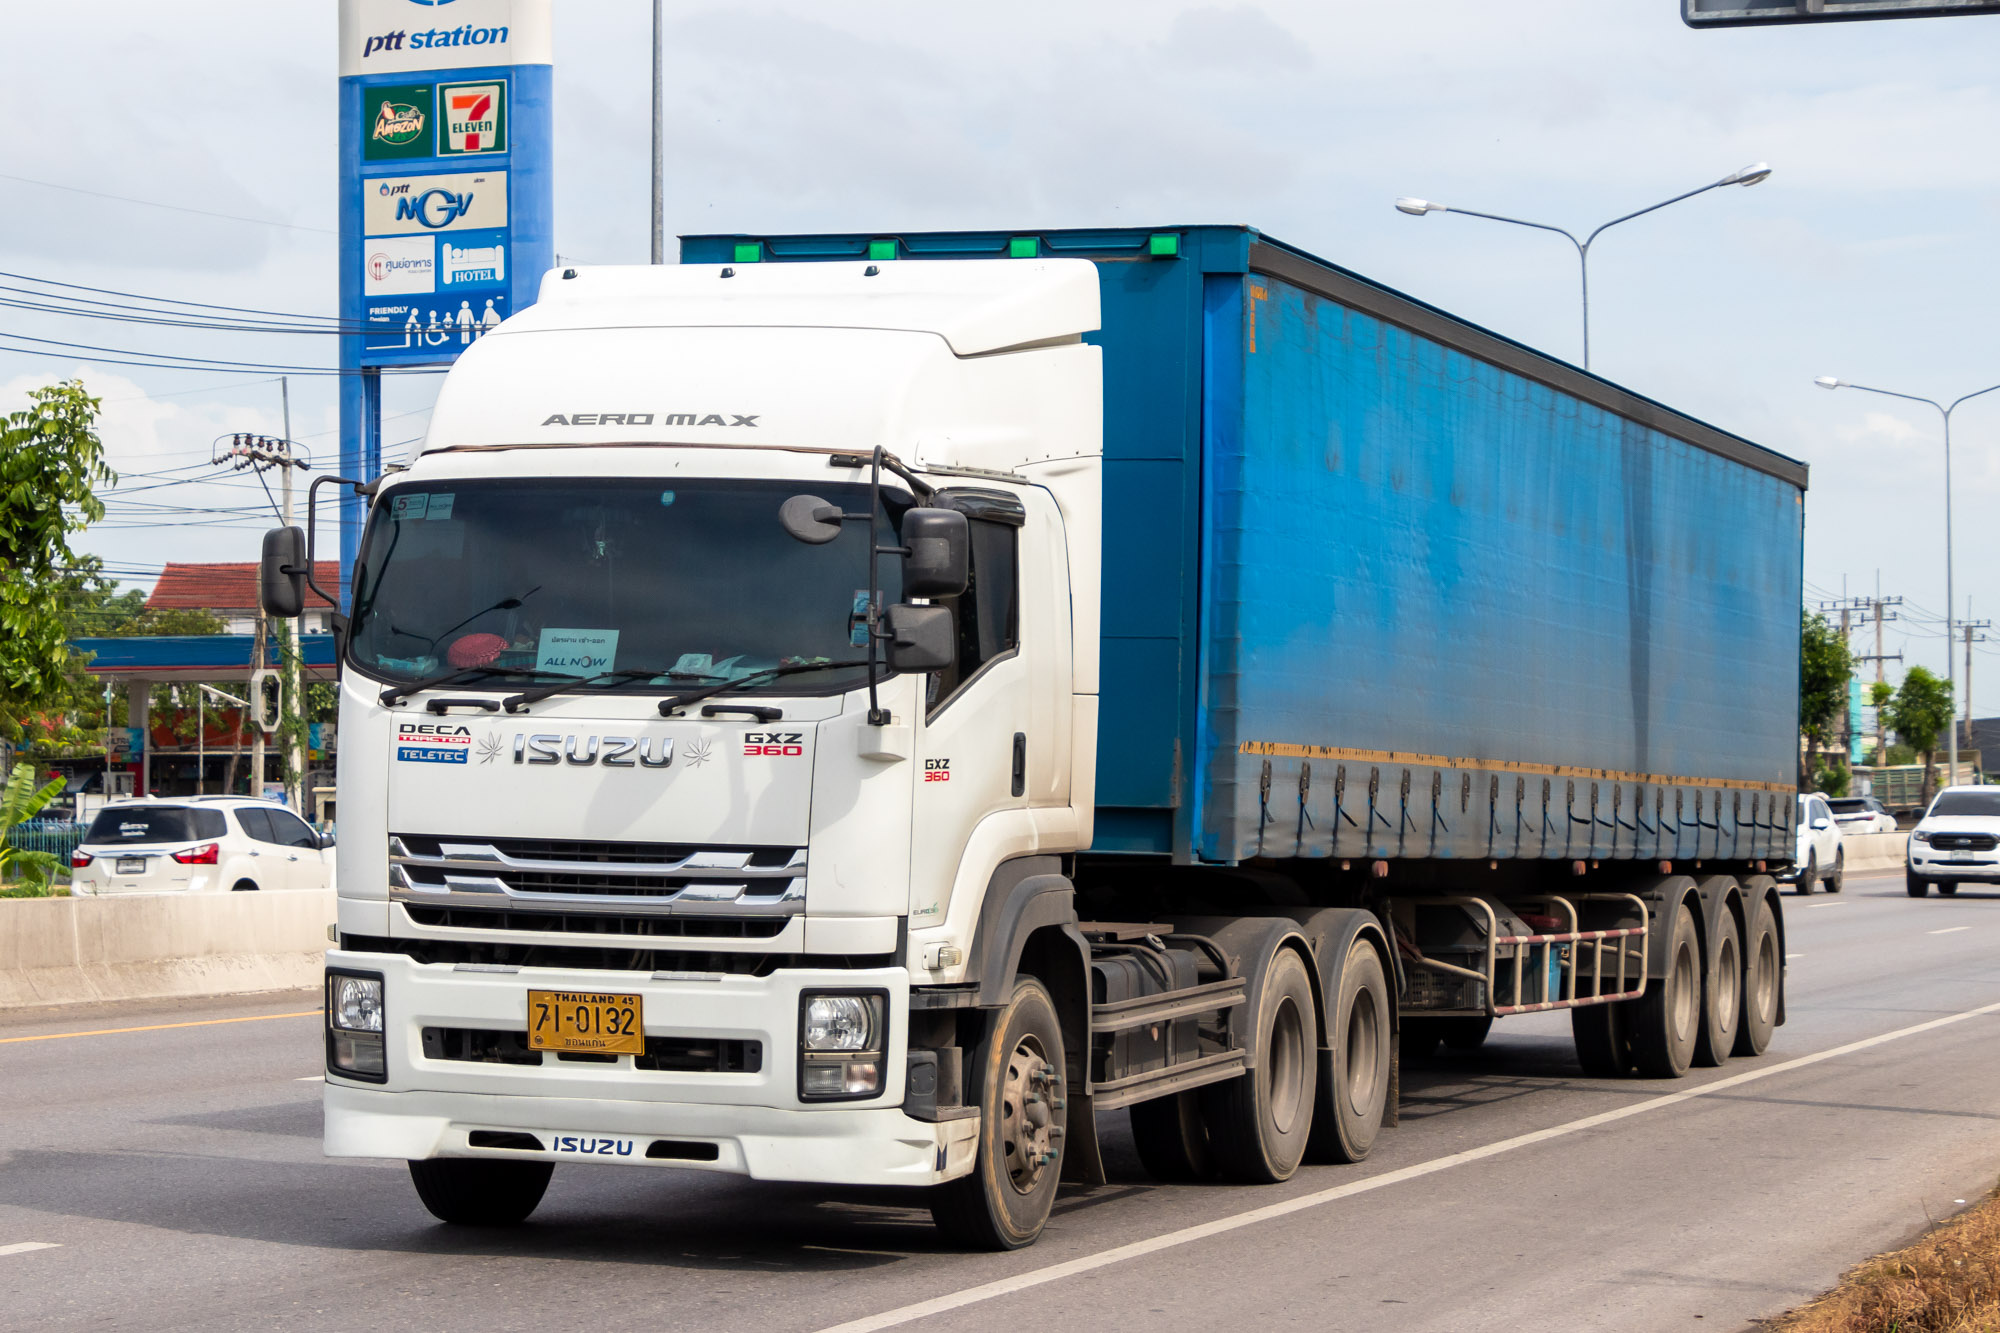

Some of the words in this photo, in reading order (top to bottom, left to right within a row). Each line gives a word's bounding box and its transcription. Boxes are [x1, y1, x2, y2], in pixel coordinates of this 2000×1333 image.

[363, 30, 406, 58] ptt
[409, 24, 509, 50] station
[390, 184, 410, 196] ptt
[395, 187, 474, 229] NGV
[386, 257, 433, 273] ศูนย์อาหาร
[455, 269, 494, 283] HOTEL
[369, 306, 409, 315] FRIENDLY
[540, 413, 655, 426] AERO
[665, 413, 761, 427] MAX
[544, 657, 567, 666] ALL
[570, 655, 607, 668] NOW
[399, 723, 471, 736] DECA
[401, 735, 470, 744] TRACTOR
[744, 733, 803, 745] GXZ
[401, 750, 465, 761] TELETEC
[513, 733, 674, 768] ISUZU
[743, 745, 803, 756] 360
[925, 758, 950, 770] GXZ
[924, 771, 950, 782] 360
[554, 993, 615, 1004] THAILAND
[622, 996, 634, 1005] 45
[535, 1003, 635, 1036] 71-0132
[564, 1037, 606, 1048] ขอนแก่น
[553, 1136, 634, 1156] ISUZU
